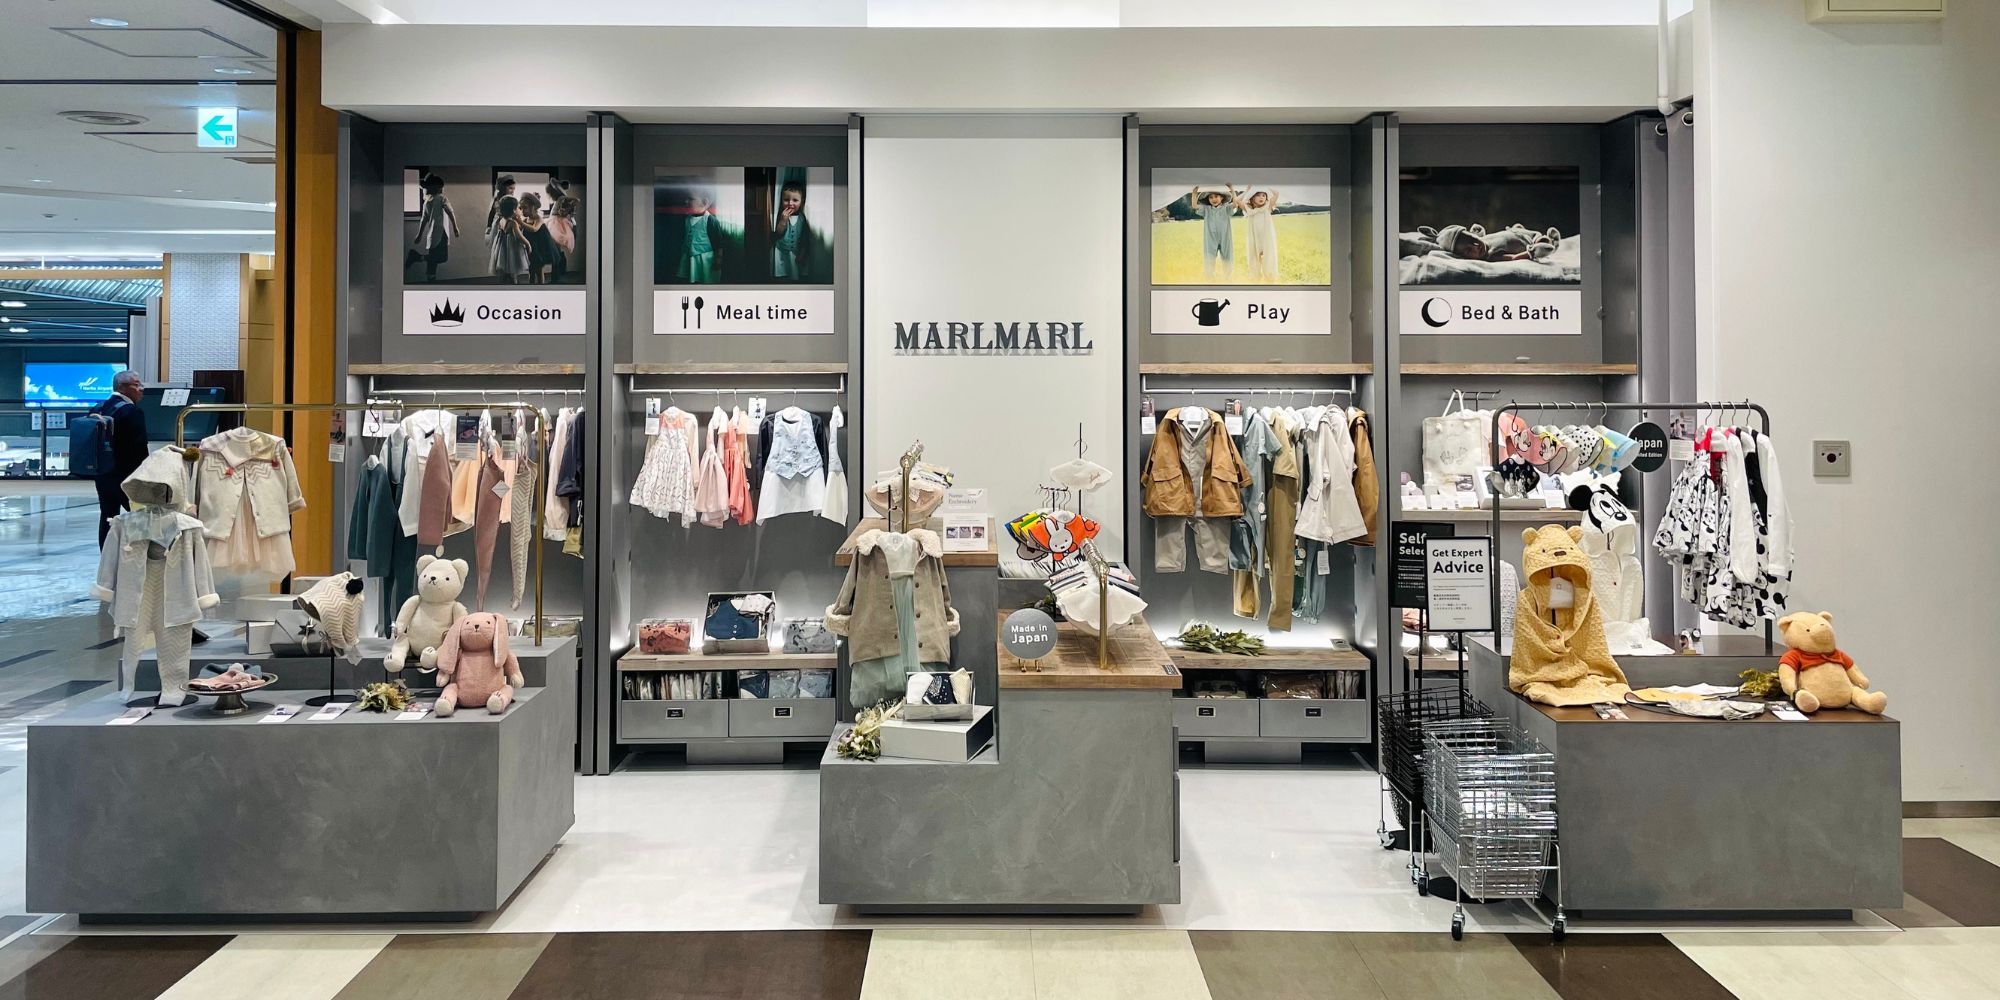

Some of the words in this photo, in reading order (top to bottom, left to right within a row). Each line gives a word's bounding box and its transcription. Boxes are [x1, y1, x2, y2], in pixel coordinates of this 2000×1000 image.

[476, 304, 562, 321] Occasion
[716, 304, 761, 320] Meal
[766, 304, 808, 320] time
[1247, 303, 1291, 324] Play
[1461, 304, 1495, 321] Bed
[1501, 304, 1513, 321] &
[1518, 304, 1560, 321] Bath
[894, 322, 1093, 350] MARLMARL
[1399, 532, 1427, 544] Self
[1432, 549, 1449, 557] Get
[1451, 549, 1483, 559] Expert
[1433, 560, 1484, 574] Advice
[1011, 624, 1036, 633] Made
[1011, 633, 1048, 645] Japan
